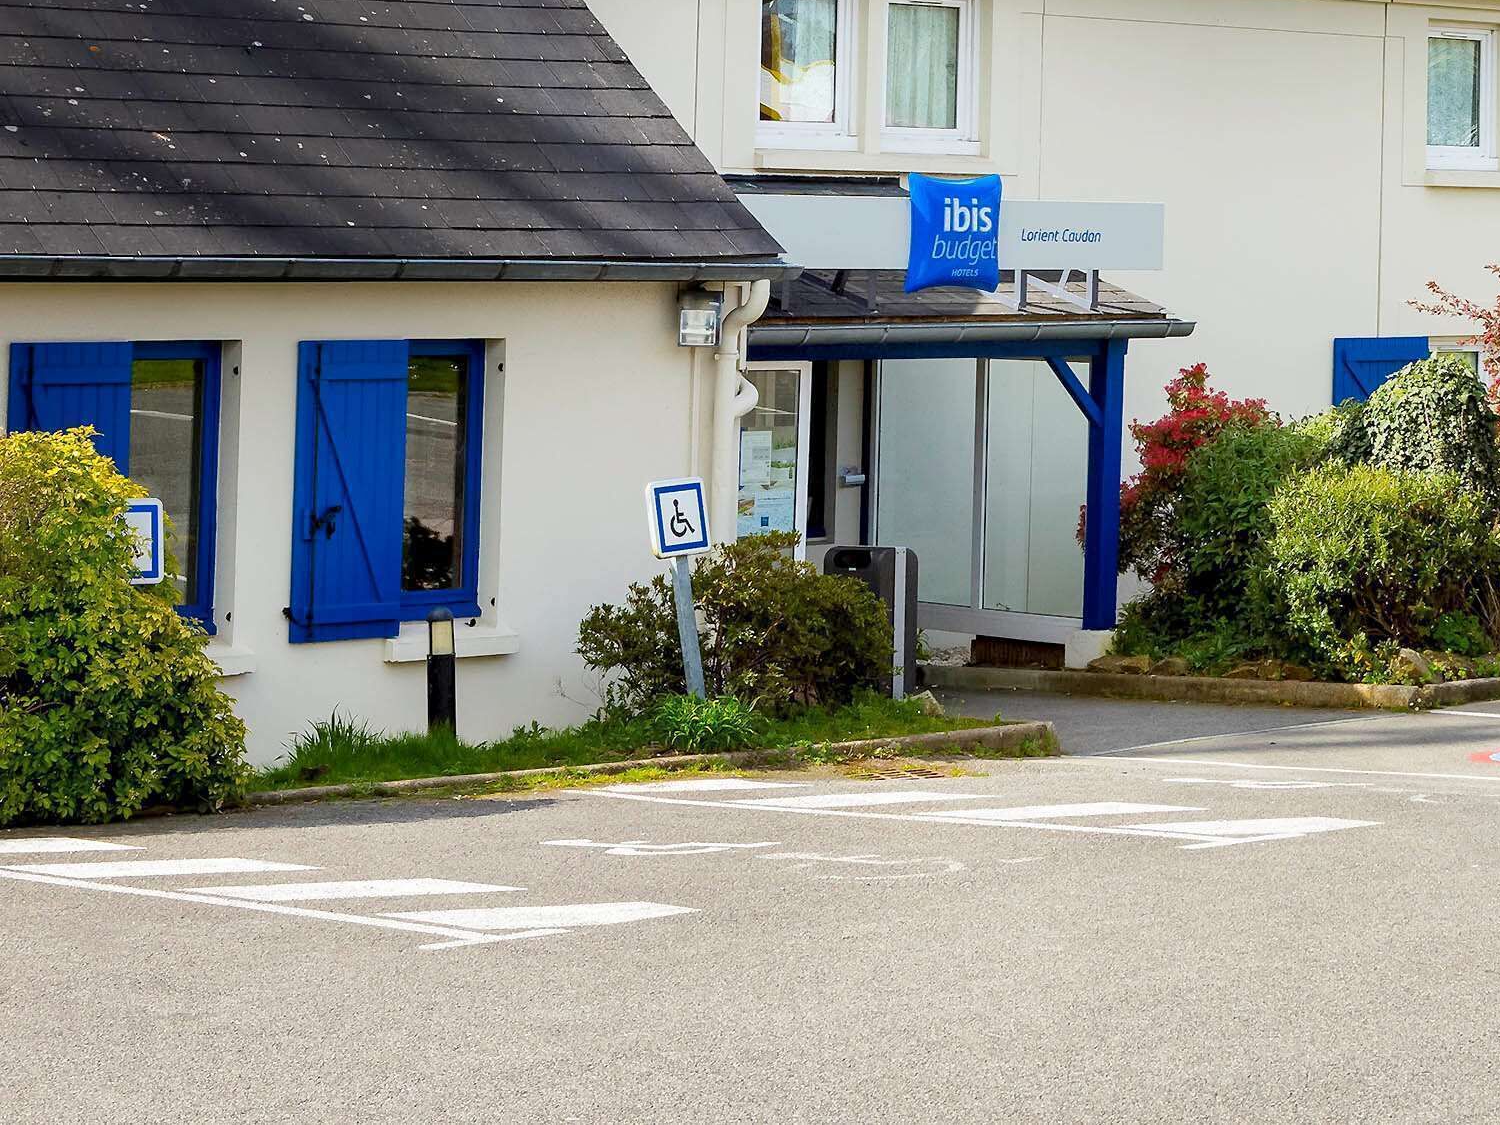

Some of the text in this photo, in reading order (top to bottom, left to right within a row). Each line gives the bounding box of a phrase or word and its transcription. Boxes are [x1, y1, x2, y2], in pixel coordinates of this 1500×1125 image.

[944, 197, 992, 232] ibis
[1021, 228, 1101, 243] Lorient Caudan
[932, 235, 997, 265] budget
[951, 268, 979, 277] HOTELS
